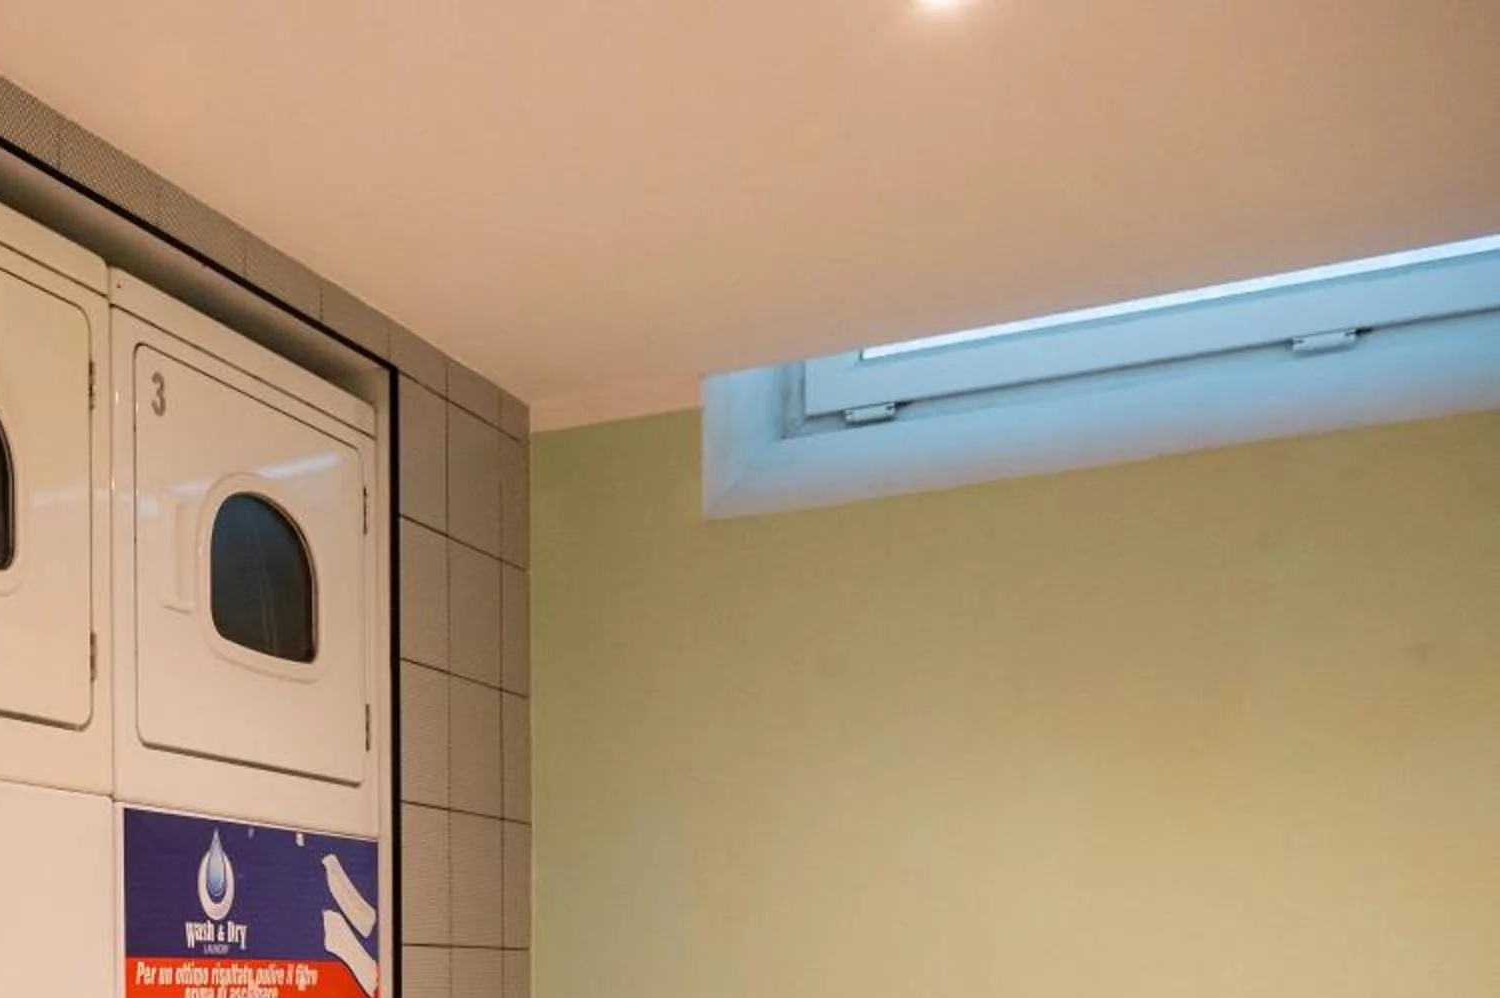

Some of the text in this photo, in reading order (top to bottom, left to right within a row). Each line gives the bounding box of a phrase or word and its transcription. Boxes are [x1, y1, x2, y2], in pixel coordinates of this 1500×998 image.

[151, 373, 167, 418] 3
[185, 920, 248, 949] Wash & Dry
[135, 961, 157, 985] Per
[159, 967, 173, 985] un
[175, 962, 210, 985] ottimo
